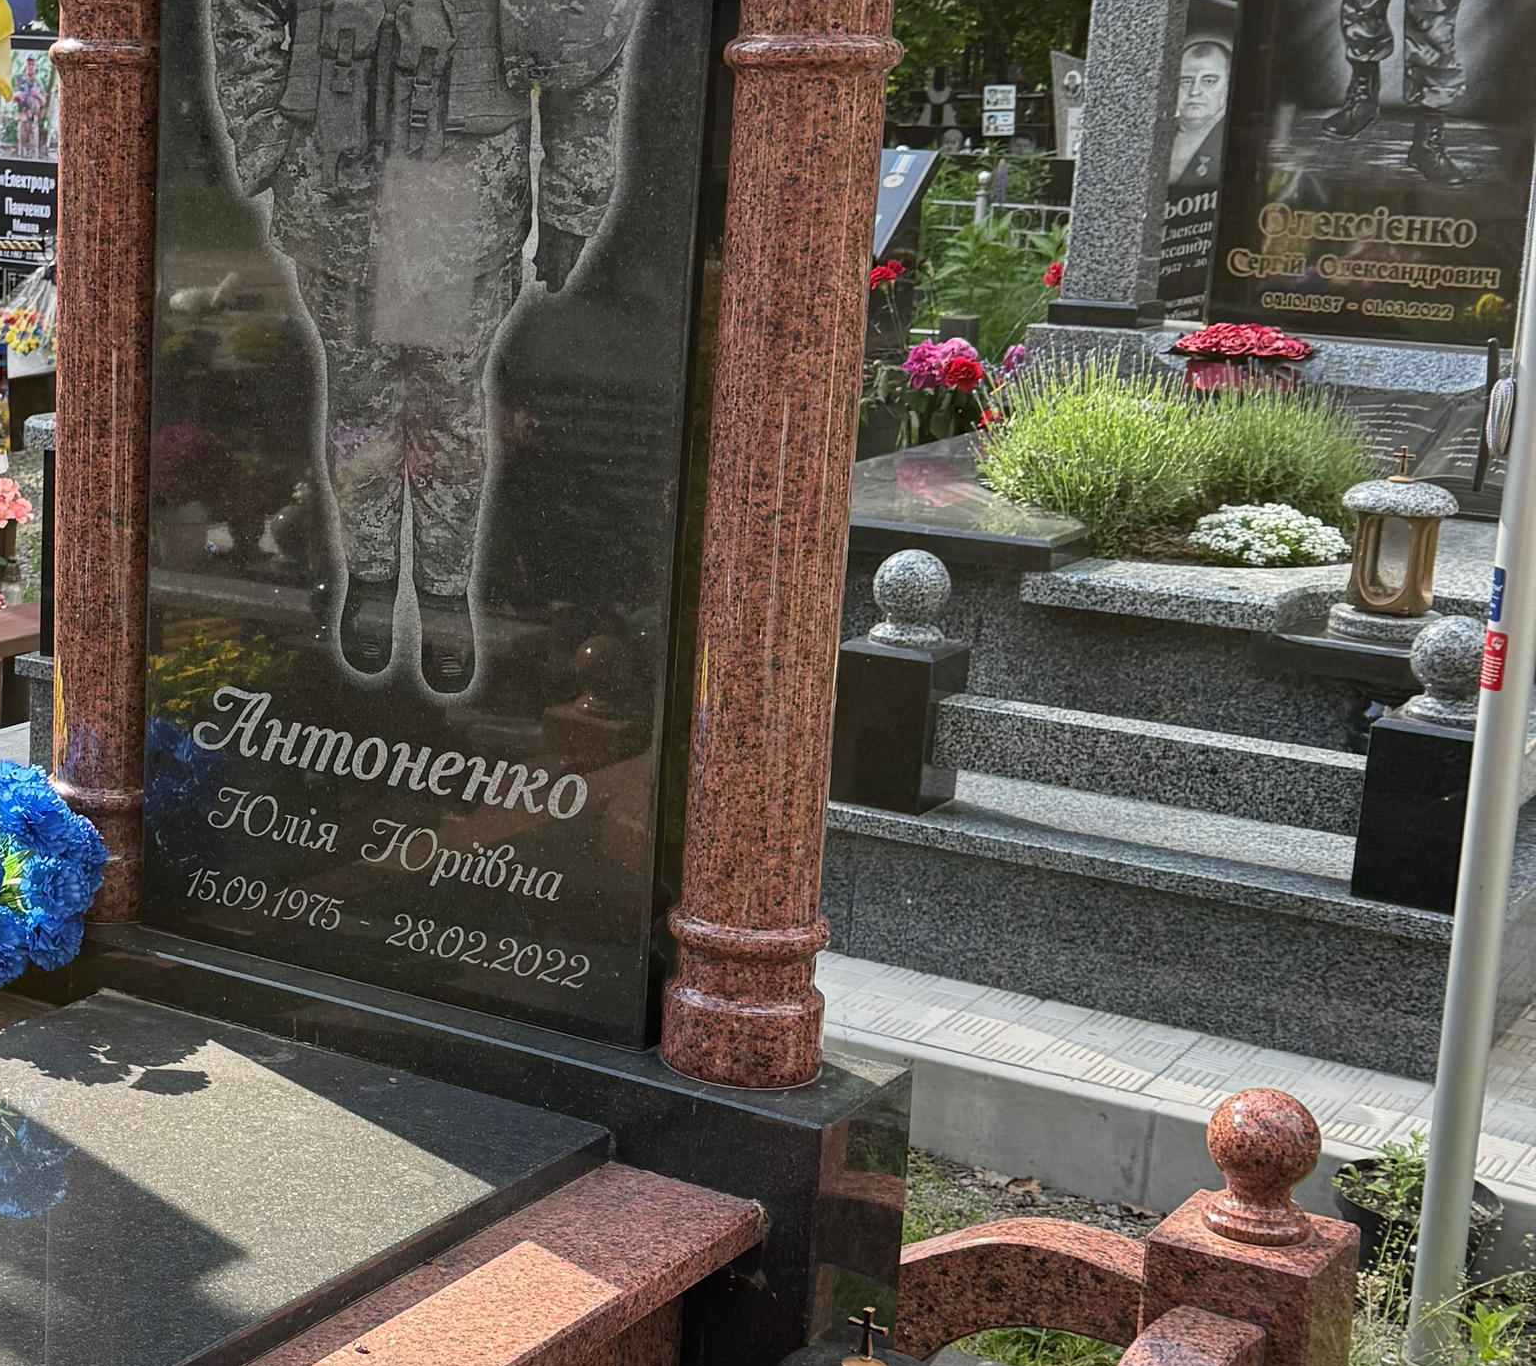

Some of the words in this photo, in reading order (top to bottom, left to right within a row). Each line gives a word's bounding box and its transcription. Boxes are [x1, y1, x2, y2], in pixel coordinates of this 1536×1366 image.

[1257, 202, 1477, 248] Олексієнко
[1226, 247, 1307, 279] Сергій
[1316, 253, 1502, 290] Олександрович
[1261, 291, 1344, 313] 04.10.1987
[1362, 297, 1455, 322] 01.03.2022
[192, 685, 588, 820] Антоненко
[207, 785, 340, 854] Юлія
[360, 817, 565, 902] Юріївна
[186, 866, 346, 931] 15.09.1975
[384, 912, 592, 990] 28.02.2022
